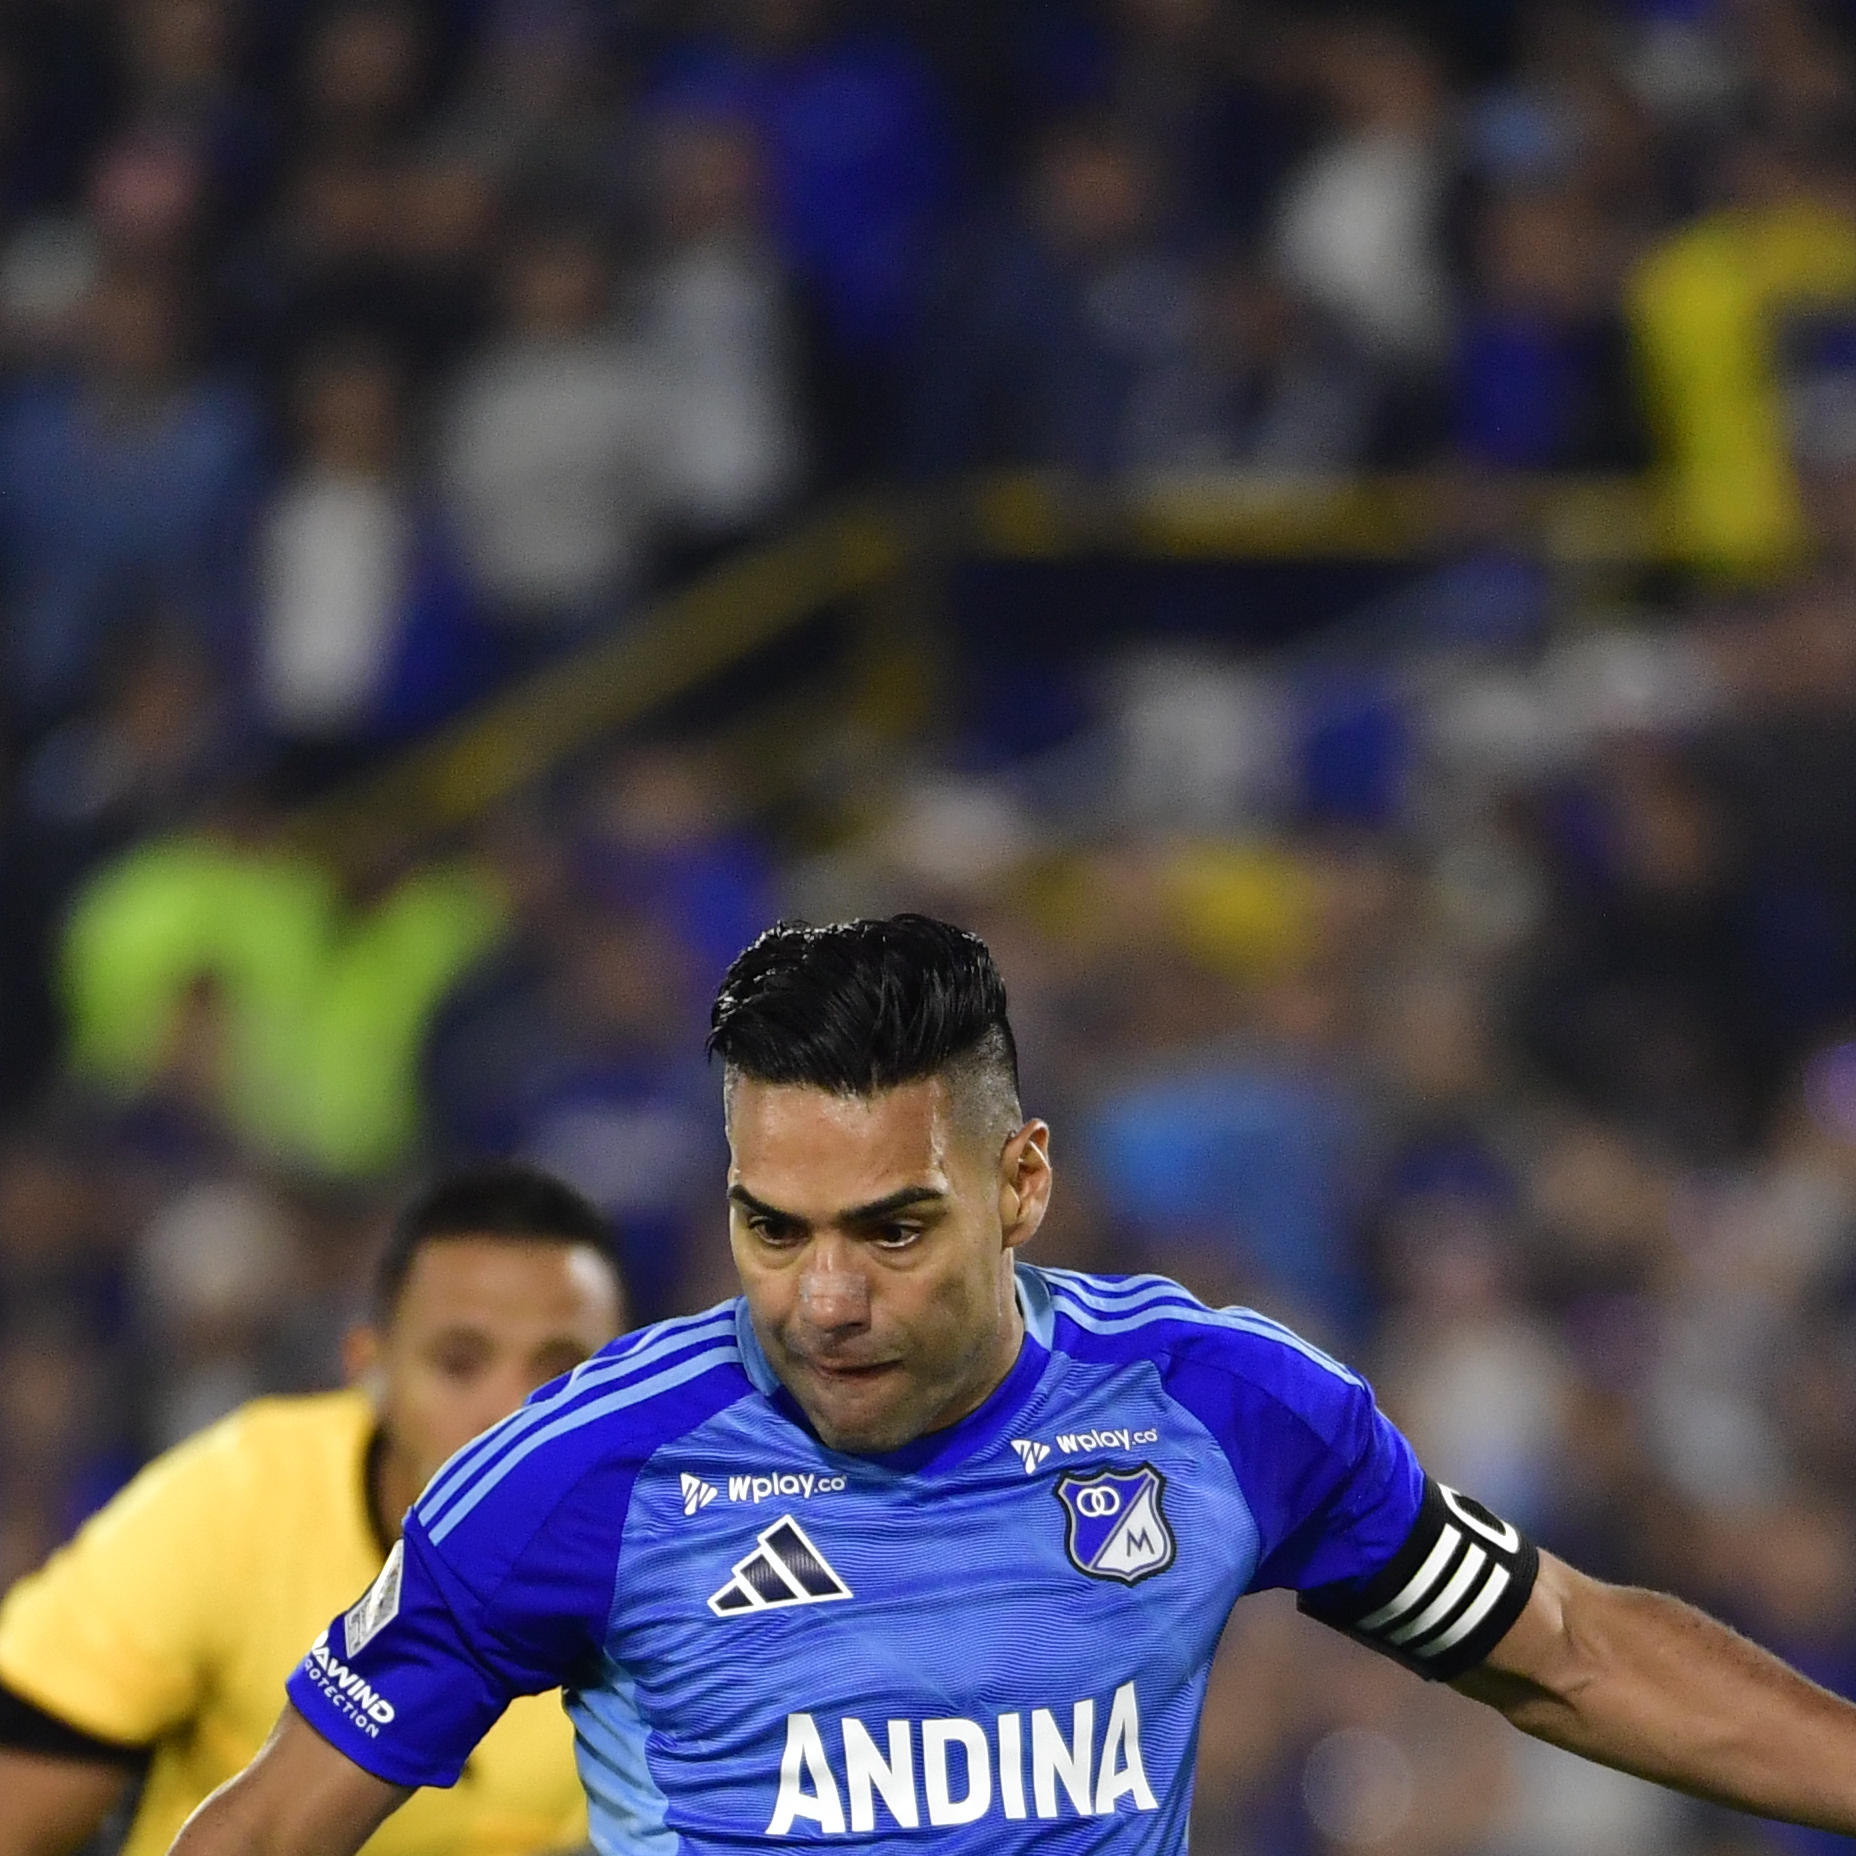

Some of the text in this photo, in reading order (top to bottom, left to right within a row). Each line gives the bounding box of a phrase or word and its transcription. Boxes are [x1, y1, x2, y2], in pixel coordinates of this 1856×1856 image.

[1126, 1527, 1155, 1557] M
[302, 1657, 380, 1739] ROTECTION
[310, 1630, 395, 1724] AWIND
[765, 1681, 1158, 1835] ANDINA
